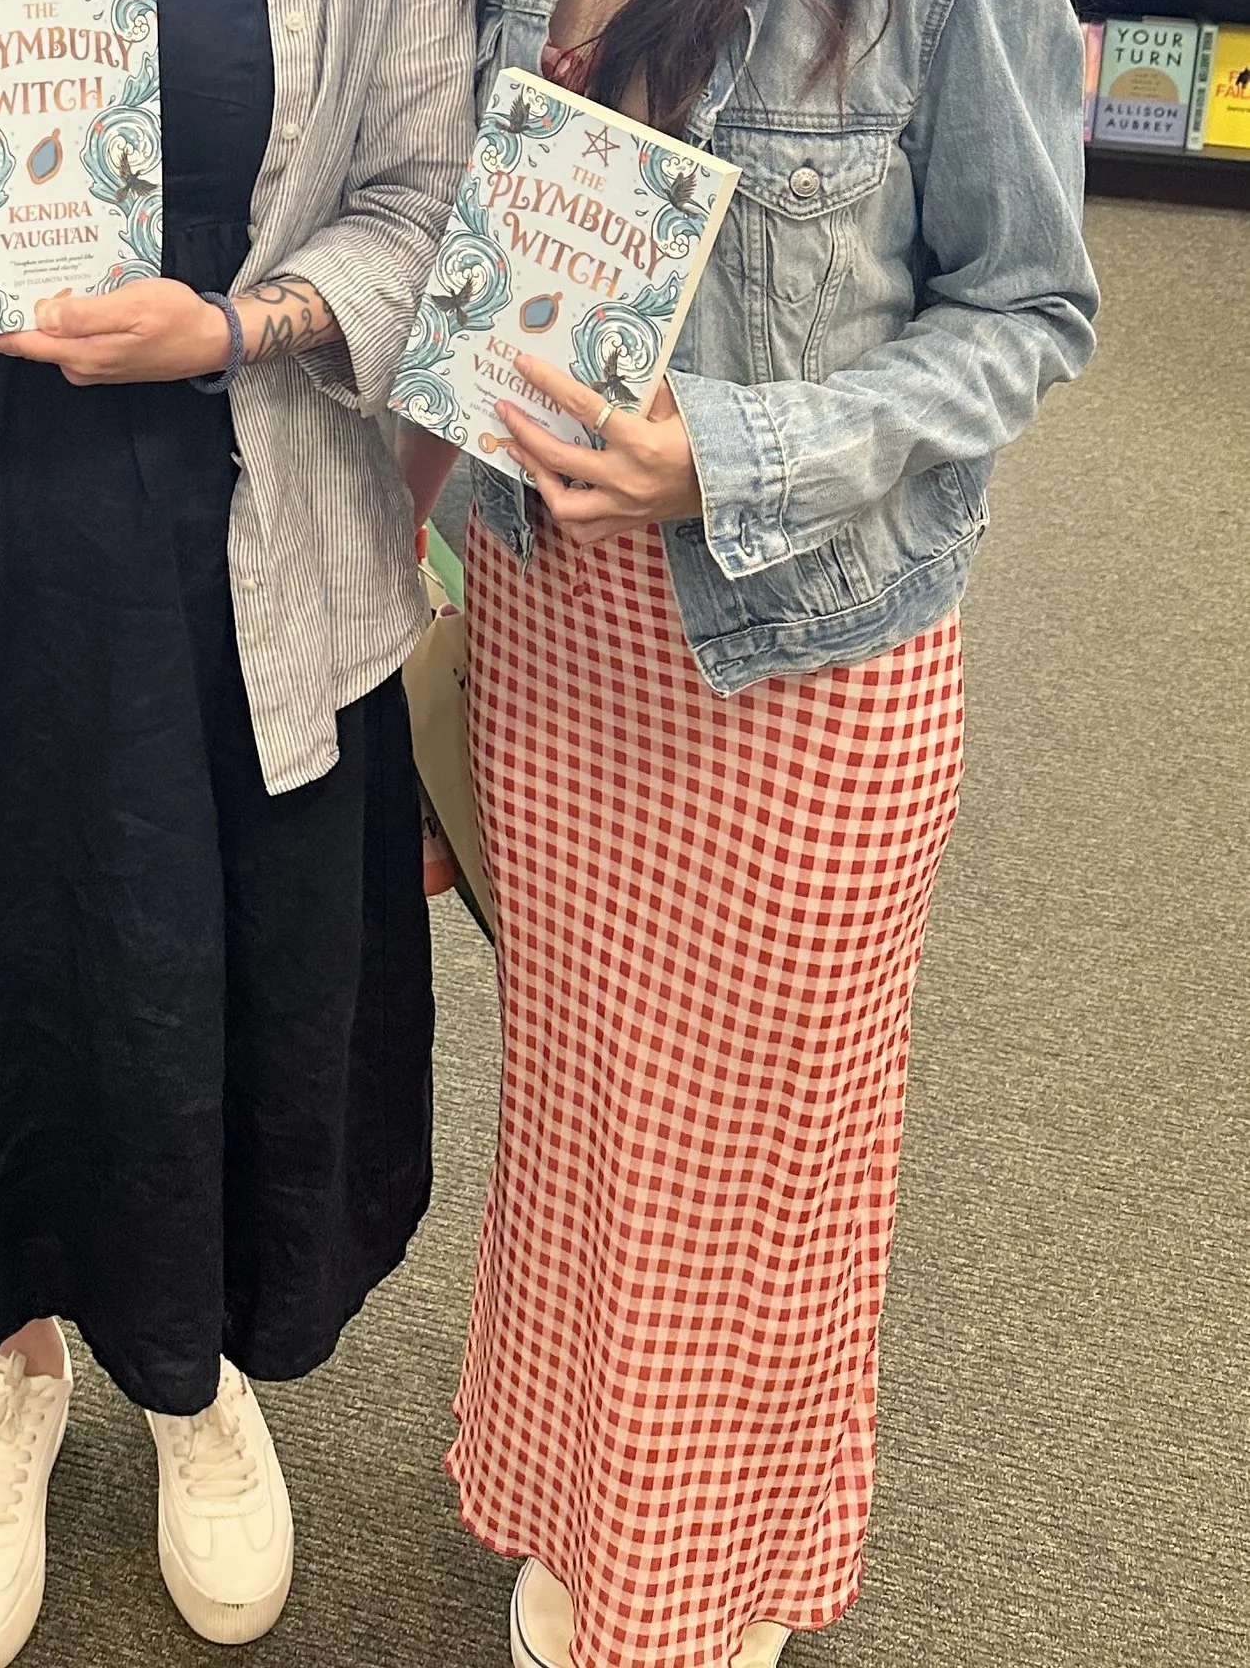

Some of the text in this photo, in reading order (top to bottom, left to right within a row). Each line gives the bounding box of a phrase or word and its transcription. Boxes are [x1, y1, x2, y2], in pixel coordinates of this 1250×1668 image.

[22, 1, 59, 20] THE
[1116, 28, 1184, 48] YOUR
[1114, 47, 1183, 68] TURN
[1104, 103, 1179, 119] ALLISON
[1105, 117, 1174, 132] AUBREY
[572, 164, 607, 192] THE
[8, 200, 93, 224] KENDRA
[487, 169, 670, 281] PLYMBURY
[0, 225, 100, 250] VAUGHAN
[502, 210, 623, 299] WITCH
[26, 275, 63, 286] ELIZABETH
[473, 352, 564, 417] VAUGHAN
